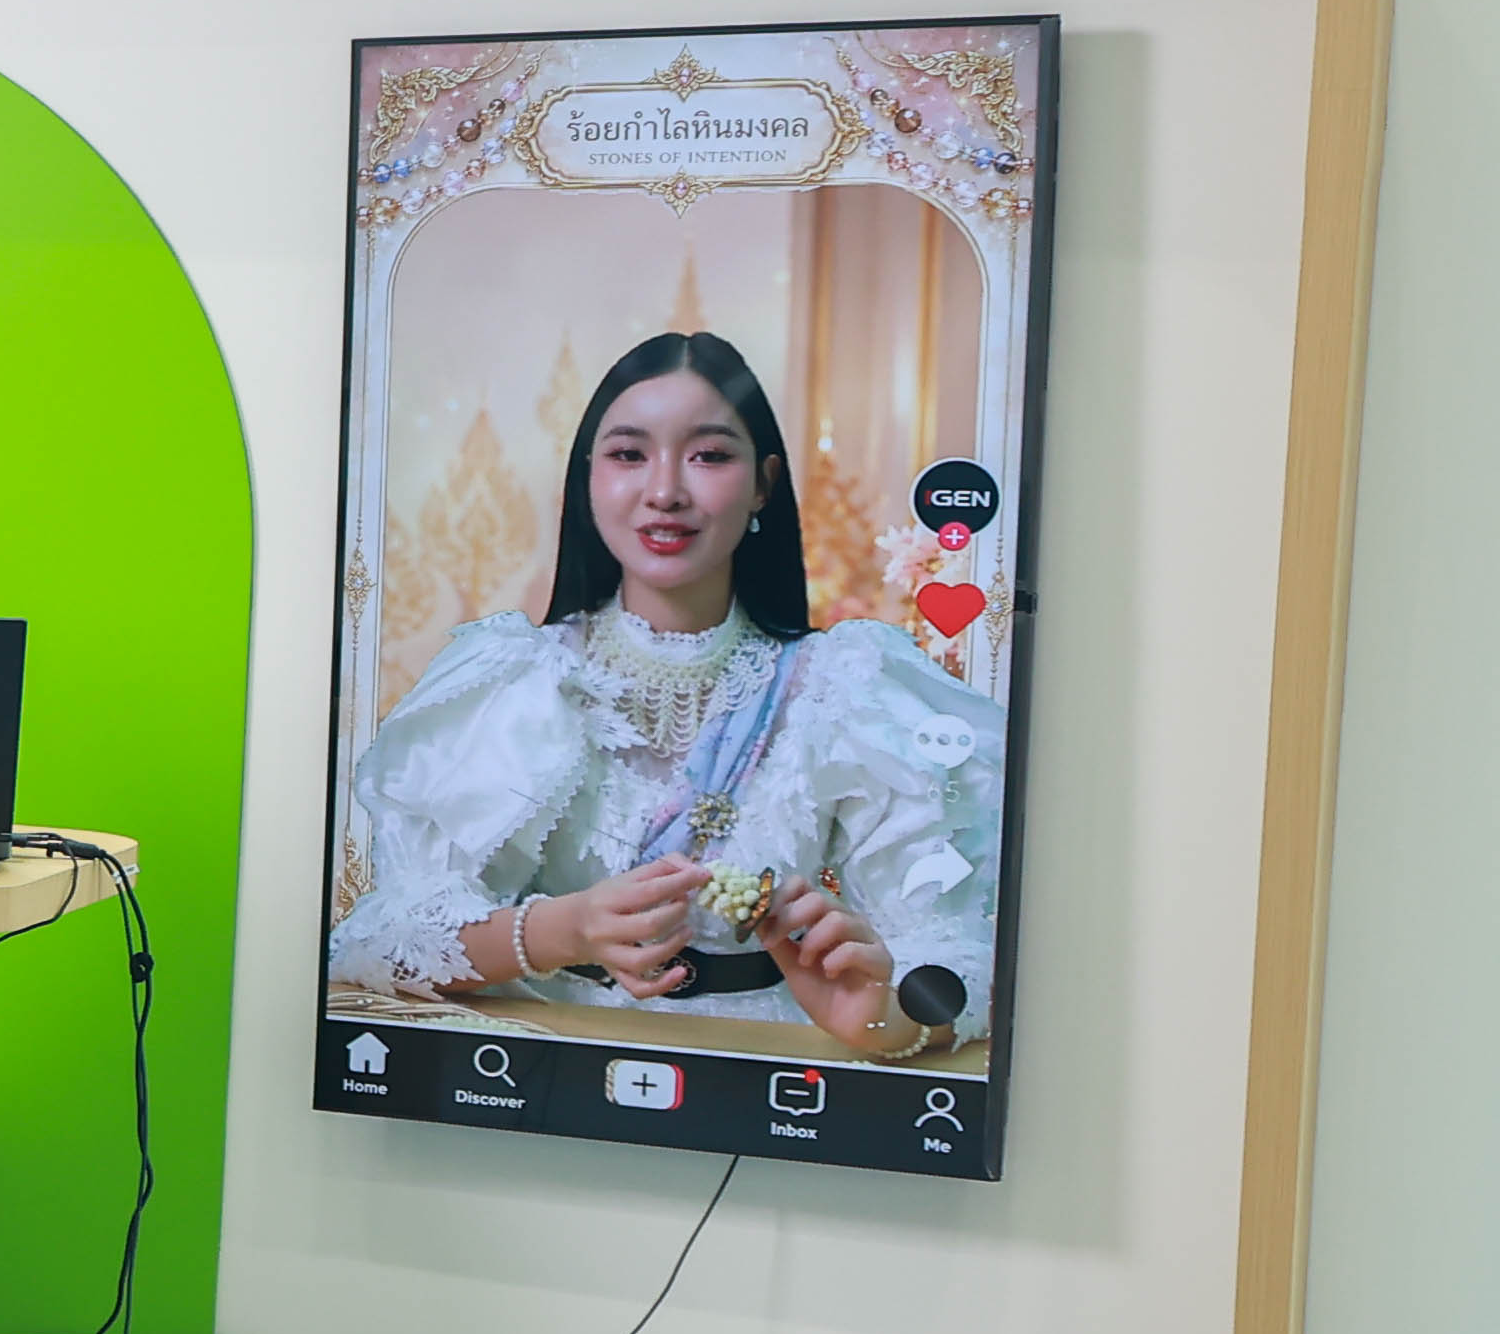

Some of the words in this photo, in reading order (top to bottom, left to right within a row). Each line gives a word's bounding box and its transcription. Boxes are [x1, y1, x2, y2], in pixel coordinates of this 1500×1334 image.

[566, 107, 809, 142] ร้อยกำไลหินมงคล
[588, 152, 653, 165] STONES
[659, 151, 682, 164] OF
[688, 150, 787, 163] INTENTION
[924, 489, 991, 508] IGEN
[343, 1078, 389, 1095] Home
[455, 1089, 526, 1109] Discover
[770, 1121, 818, 1140] Inbox
[923, 1137, 952, 1153] Me
